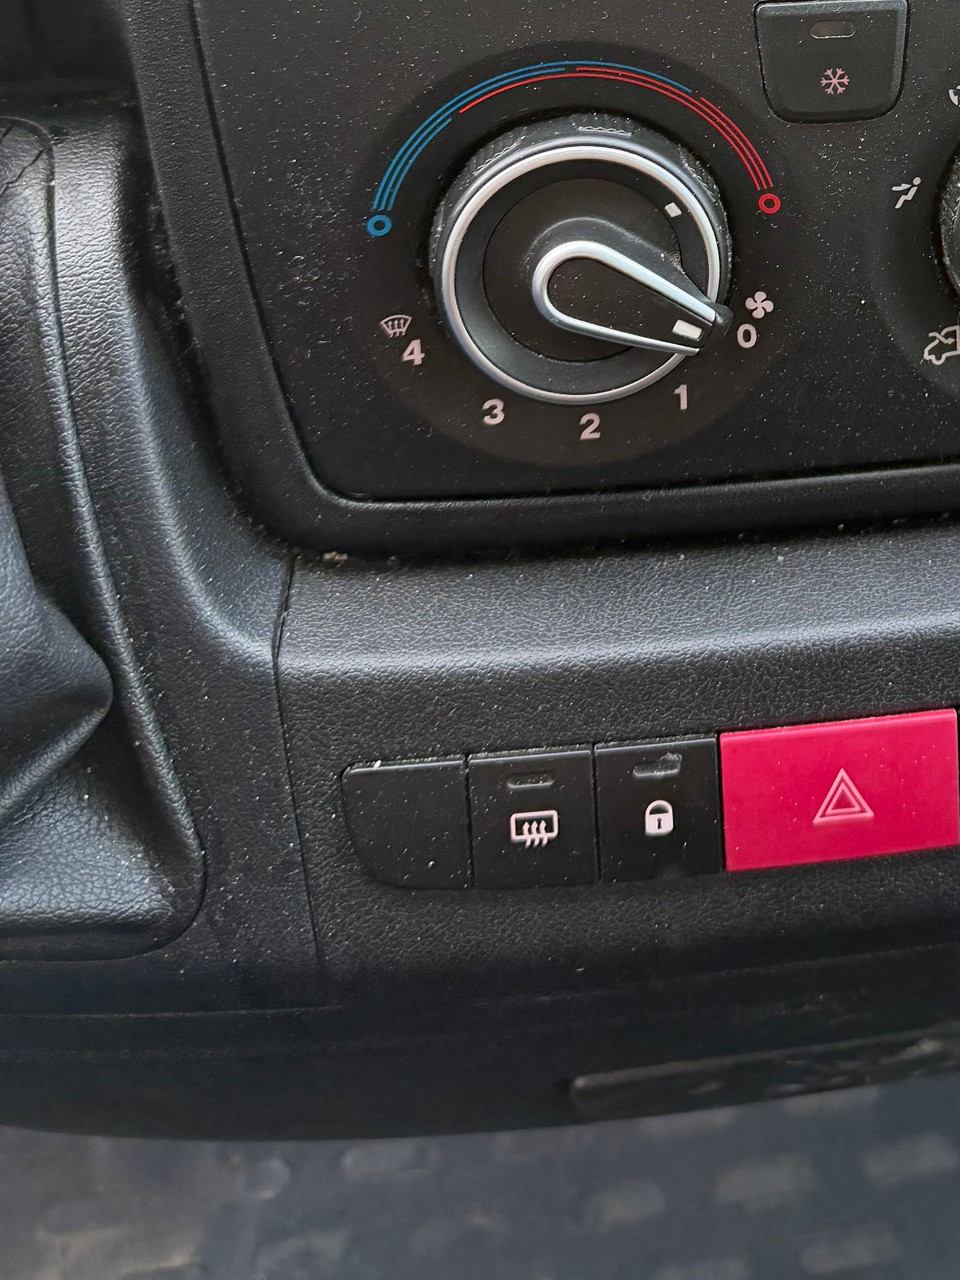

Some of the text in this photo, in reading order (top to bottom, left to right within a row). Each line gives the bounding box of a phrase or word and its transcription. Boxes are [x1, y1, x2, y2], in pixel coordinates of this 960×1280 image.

[736, 323, 758, 349] 0
[402, 338, 425, 366] 4
[673, 384, 689, 411] 1
[482, 398, 506, 426] 3
[579, 412, 602, 440] 2
